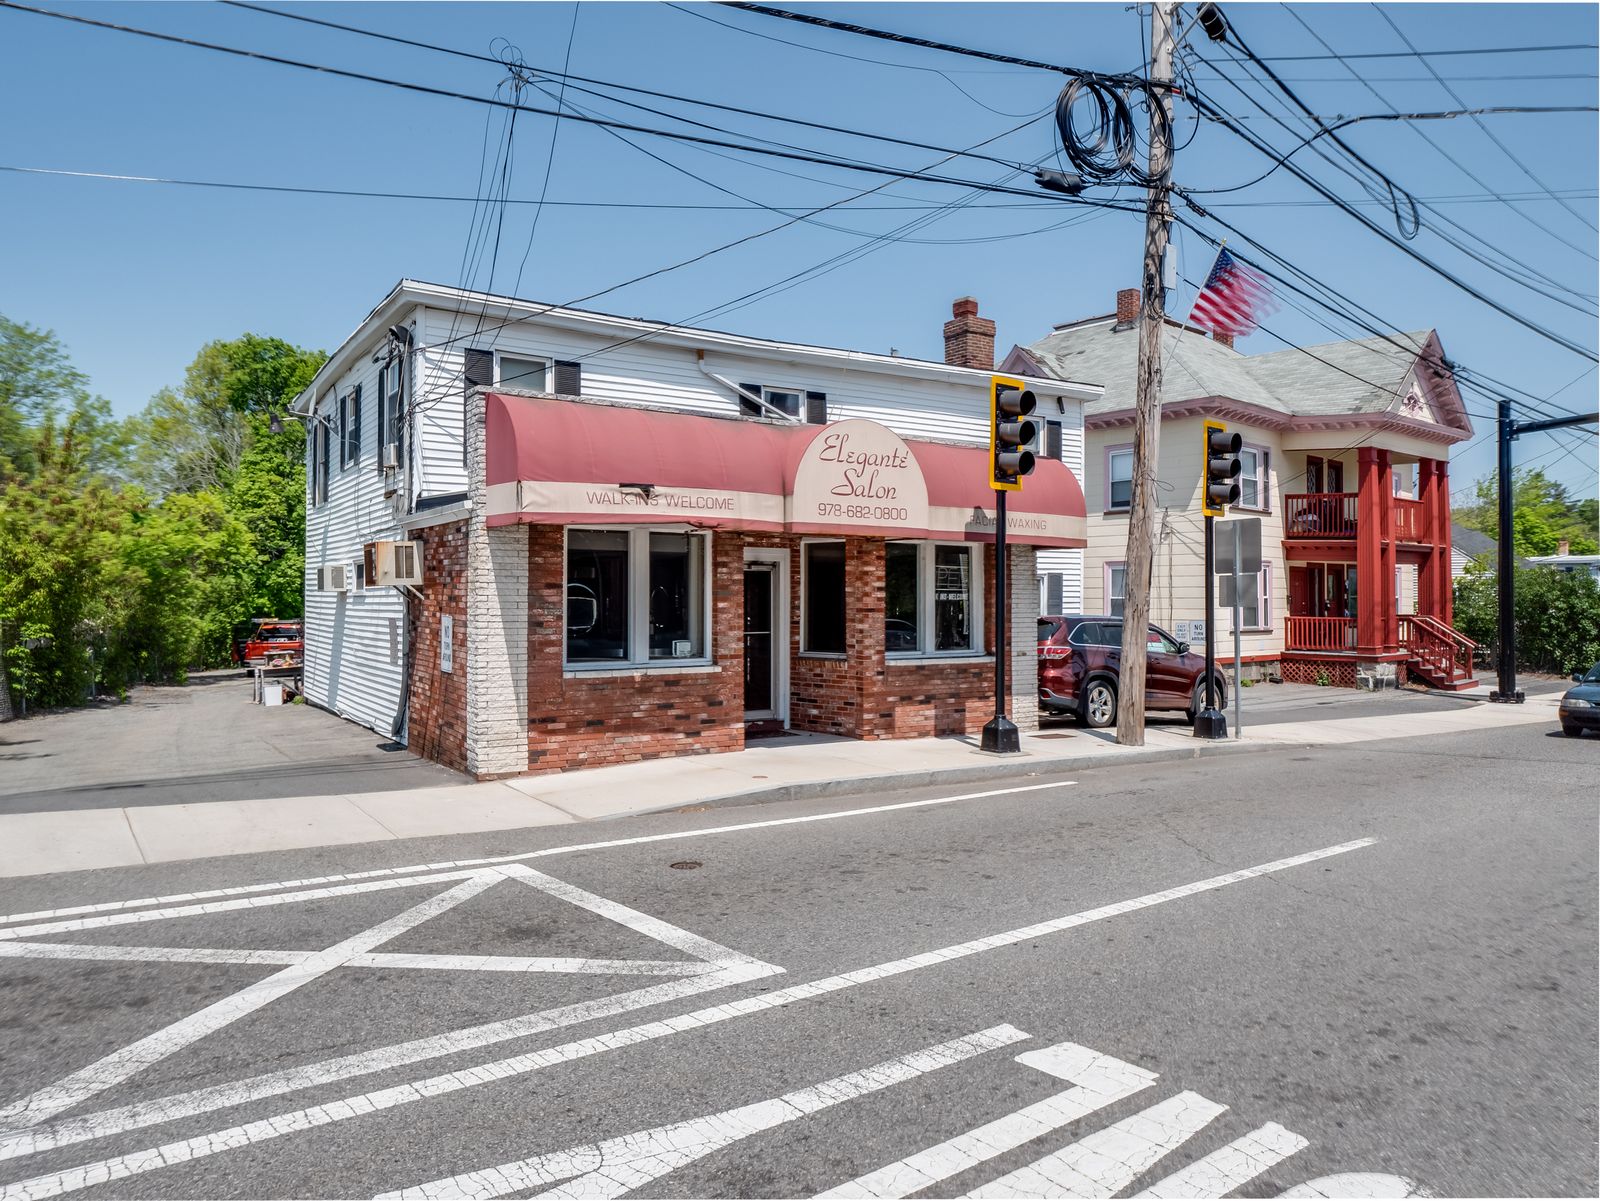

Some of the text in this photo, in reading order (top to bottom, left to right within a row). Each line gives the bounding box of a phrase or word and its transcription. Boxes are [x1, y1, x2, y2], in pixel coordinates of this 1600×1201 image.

[831, 468, 897, 500] Salon
[586, 491, 735, 511] WALK-INS WELCOME
[818, 502, 908, 521] 978-682-0800
[970, 514, 1048, 530] FACIA WAXING
